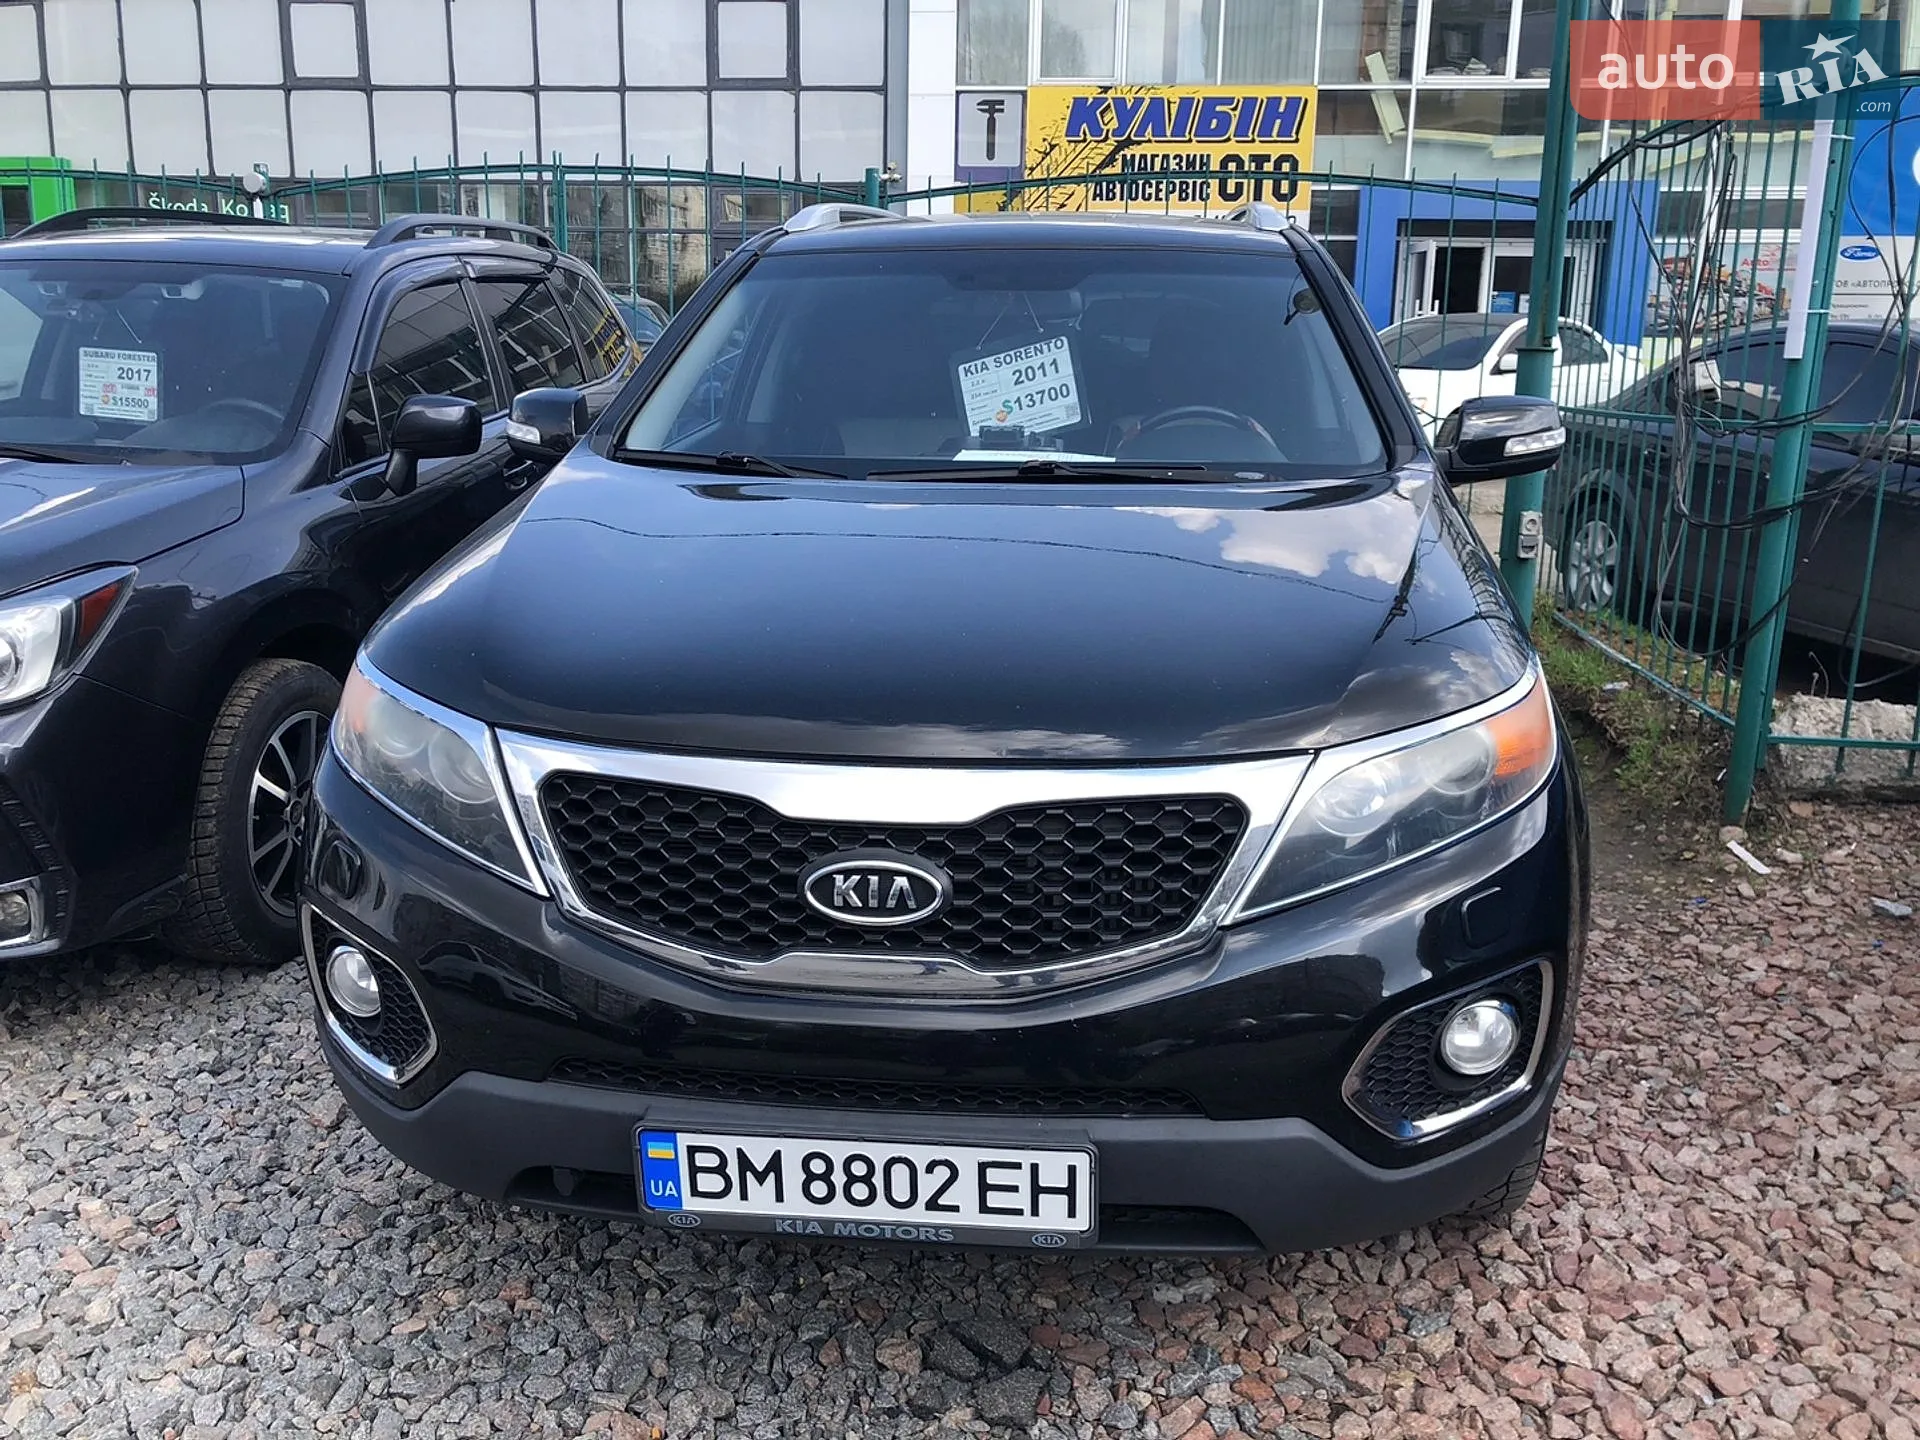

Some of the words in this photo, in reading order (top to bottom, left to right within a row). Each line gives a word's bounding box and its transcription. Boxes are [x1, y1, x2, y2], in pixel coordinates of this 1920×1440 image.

[1064, 95, 1309, 143] КУЛІБІН
[1121, 153, 1211, 173] МАГАЗИН
[1218, 153, 1299, 203] СТО
[1092, 179, 1212, 202] АВТОСЕРВІС
[963, 360, 990, 378] KIA
[993, 338, 1064, 369] SORENTO
[1011, 357, 1060, 387] 2011
[116, 366, 152, 382] 2017
[111, 395, 150, 409] $15500
[1001, 383, 1070, 415] $13700
[832, 873, 918, 909] KIA
[650, 1179, 679, 1198] UA
[685, 1143, 785, 1204] BM
[801, 1150, 961, 1214] 8802
[977, 1160, 1078, 1220] EH
[775, 1218, 825, 1235] KIA
[832, 1222, 954, 1242] MOTORS
